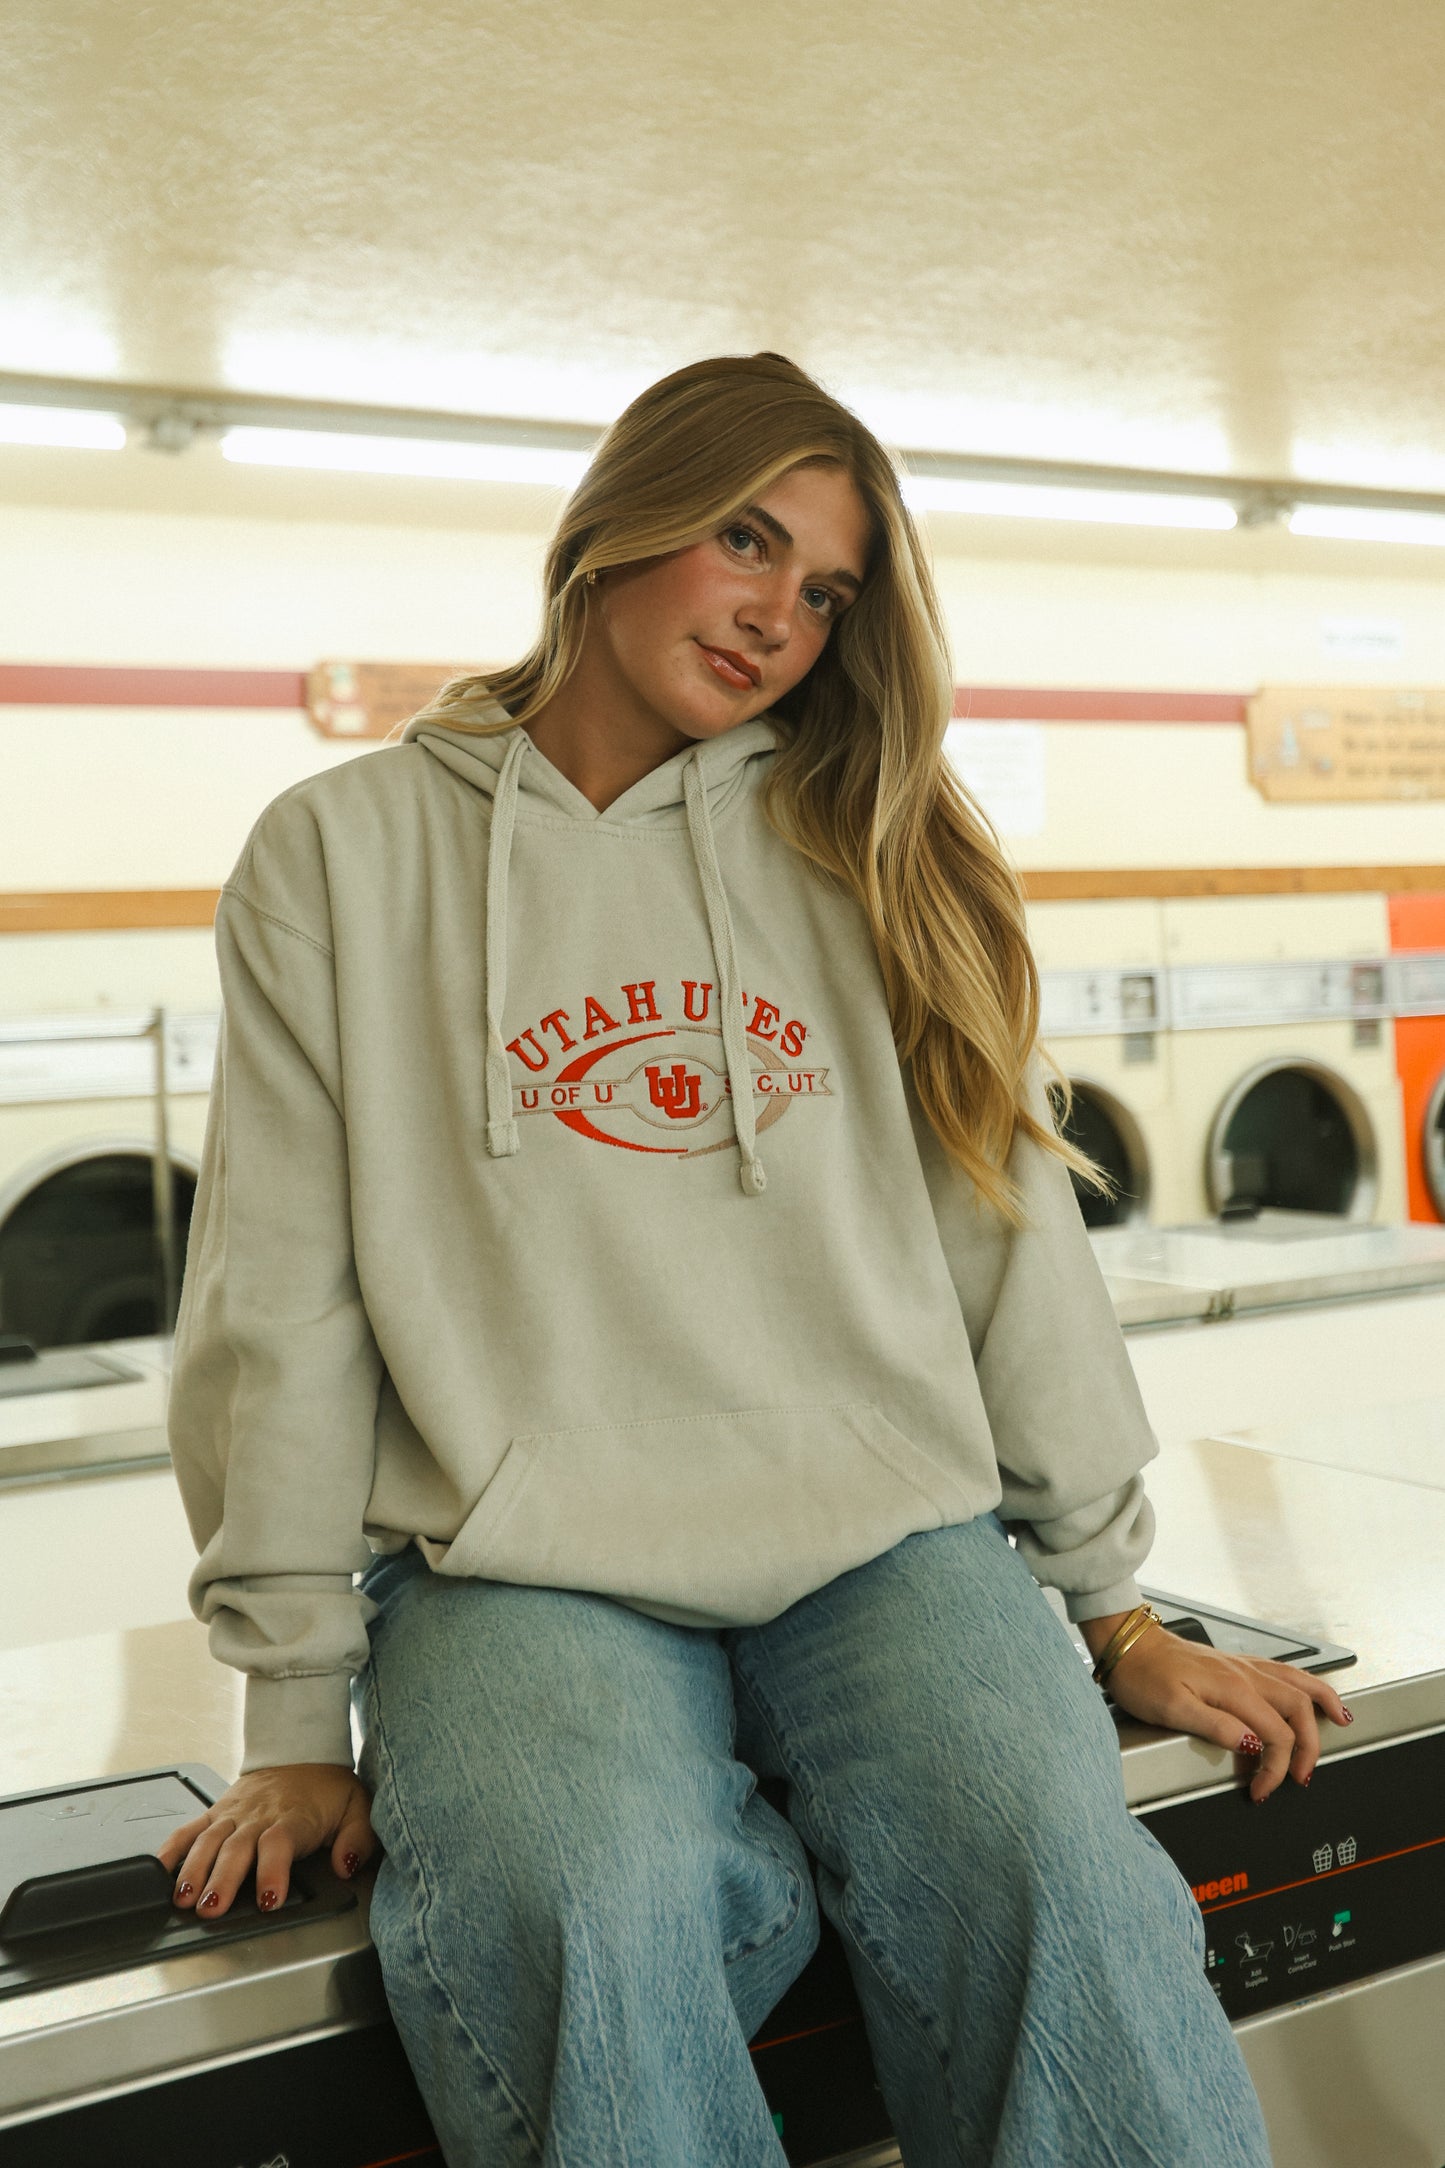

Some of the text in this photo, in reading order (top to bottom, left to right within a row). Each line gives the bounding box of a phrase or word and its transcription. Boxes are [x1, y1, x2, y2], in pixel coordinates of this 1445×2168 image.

[505, 980, 806, 1072] UTAH UES
[788, 1073, 815, 1092] UT
[521, 1089, 539, 1109] U
[551, 1086, 581, 1106] OF
[1191, 1871, 1248, 1903] ueen
